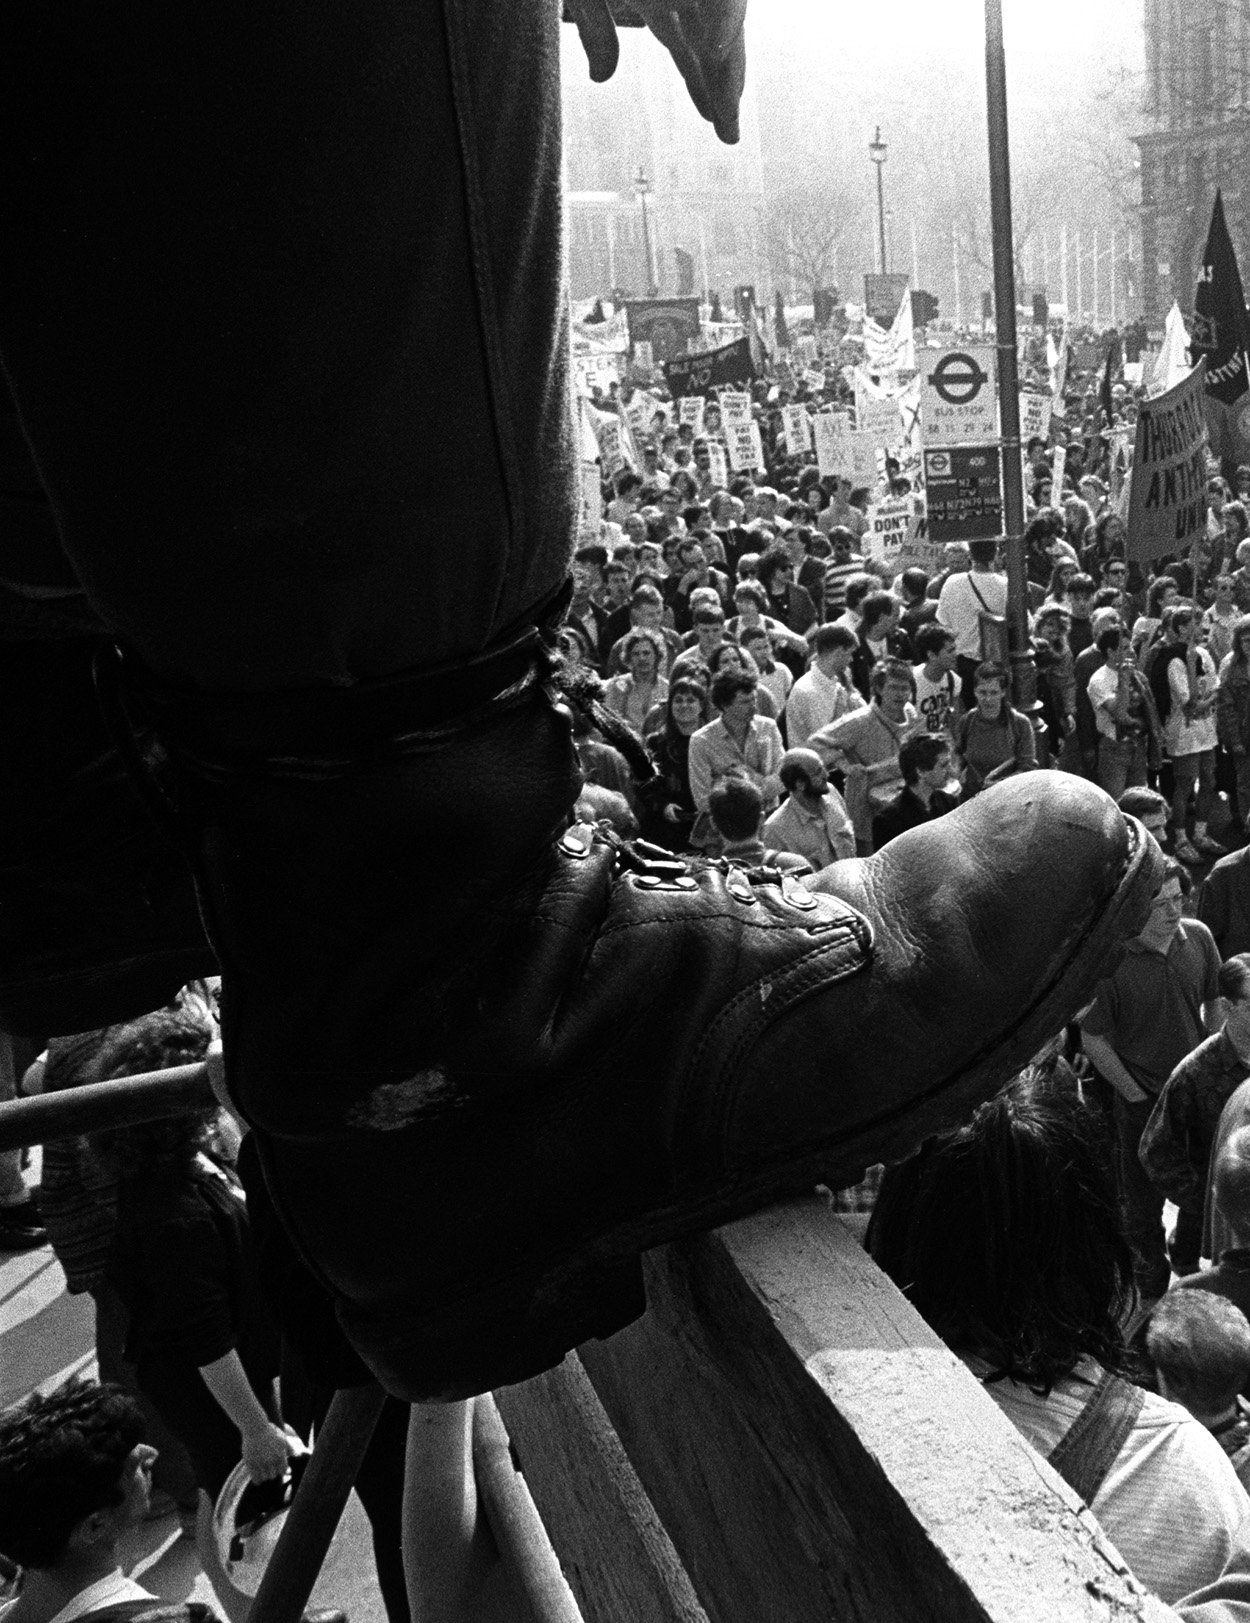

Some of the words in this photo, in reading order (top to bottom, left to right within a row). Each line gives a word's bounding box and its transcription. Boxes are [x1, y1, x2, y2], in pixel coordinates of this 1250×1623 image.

[935, 406, 955, 417] BUS
[957, 406, 985, 416] STOP
[875, 514, 910, 533] DON'T
[883, 532, 904, 548] PAY
